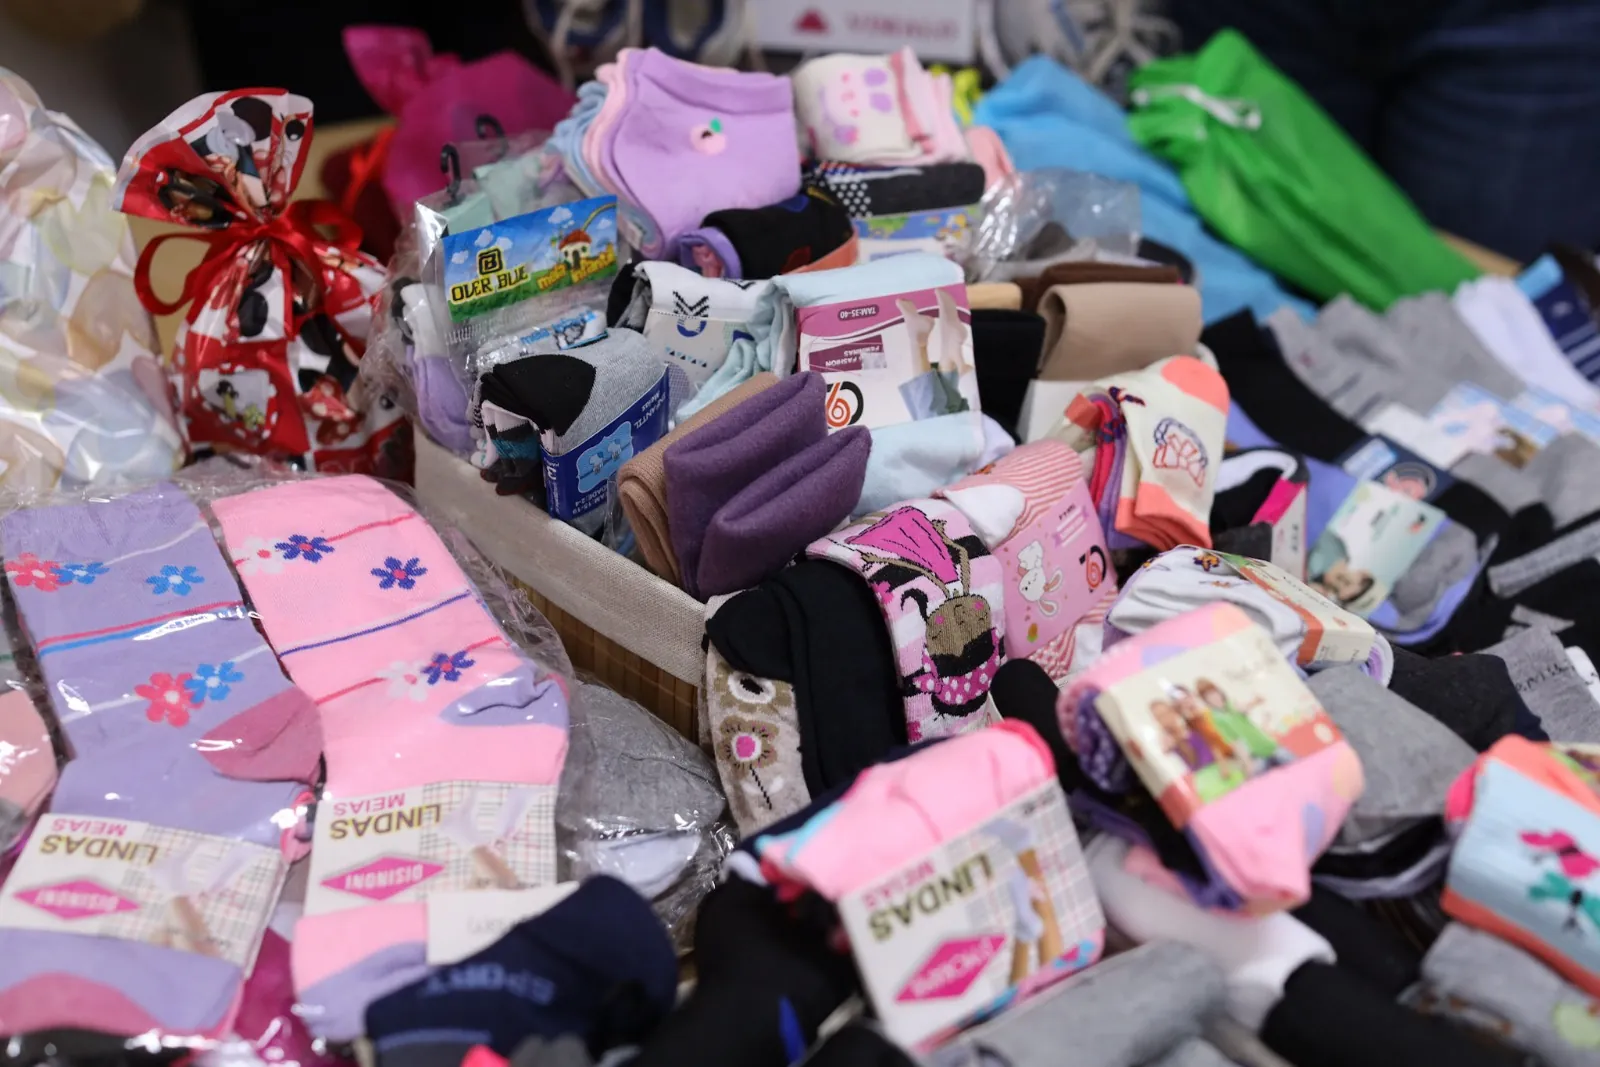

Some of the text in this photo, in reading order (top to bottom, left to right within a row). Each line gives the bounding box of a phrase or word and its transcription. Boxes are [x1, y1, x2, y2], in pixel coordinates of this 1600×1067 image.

[451, 264, 529, 302] OVER BLUE
[839, 306, 877, 319] TAM:35-40
[825, 355, 858, 368] FASHION
[572, 492, 609, 515] AM:15-19
[575, 485, 609, 508] DADE:2-4
[332, 791, 406, 817] MEIAS
[51, 817, 128, 837] MEIAS
[329, 803, 441, 840] LINDAS
[39, 834, 160, 866] LINDAS
[867, 851, 995, 944] LINDAS
